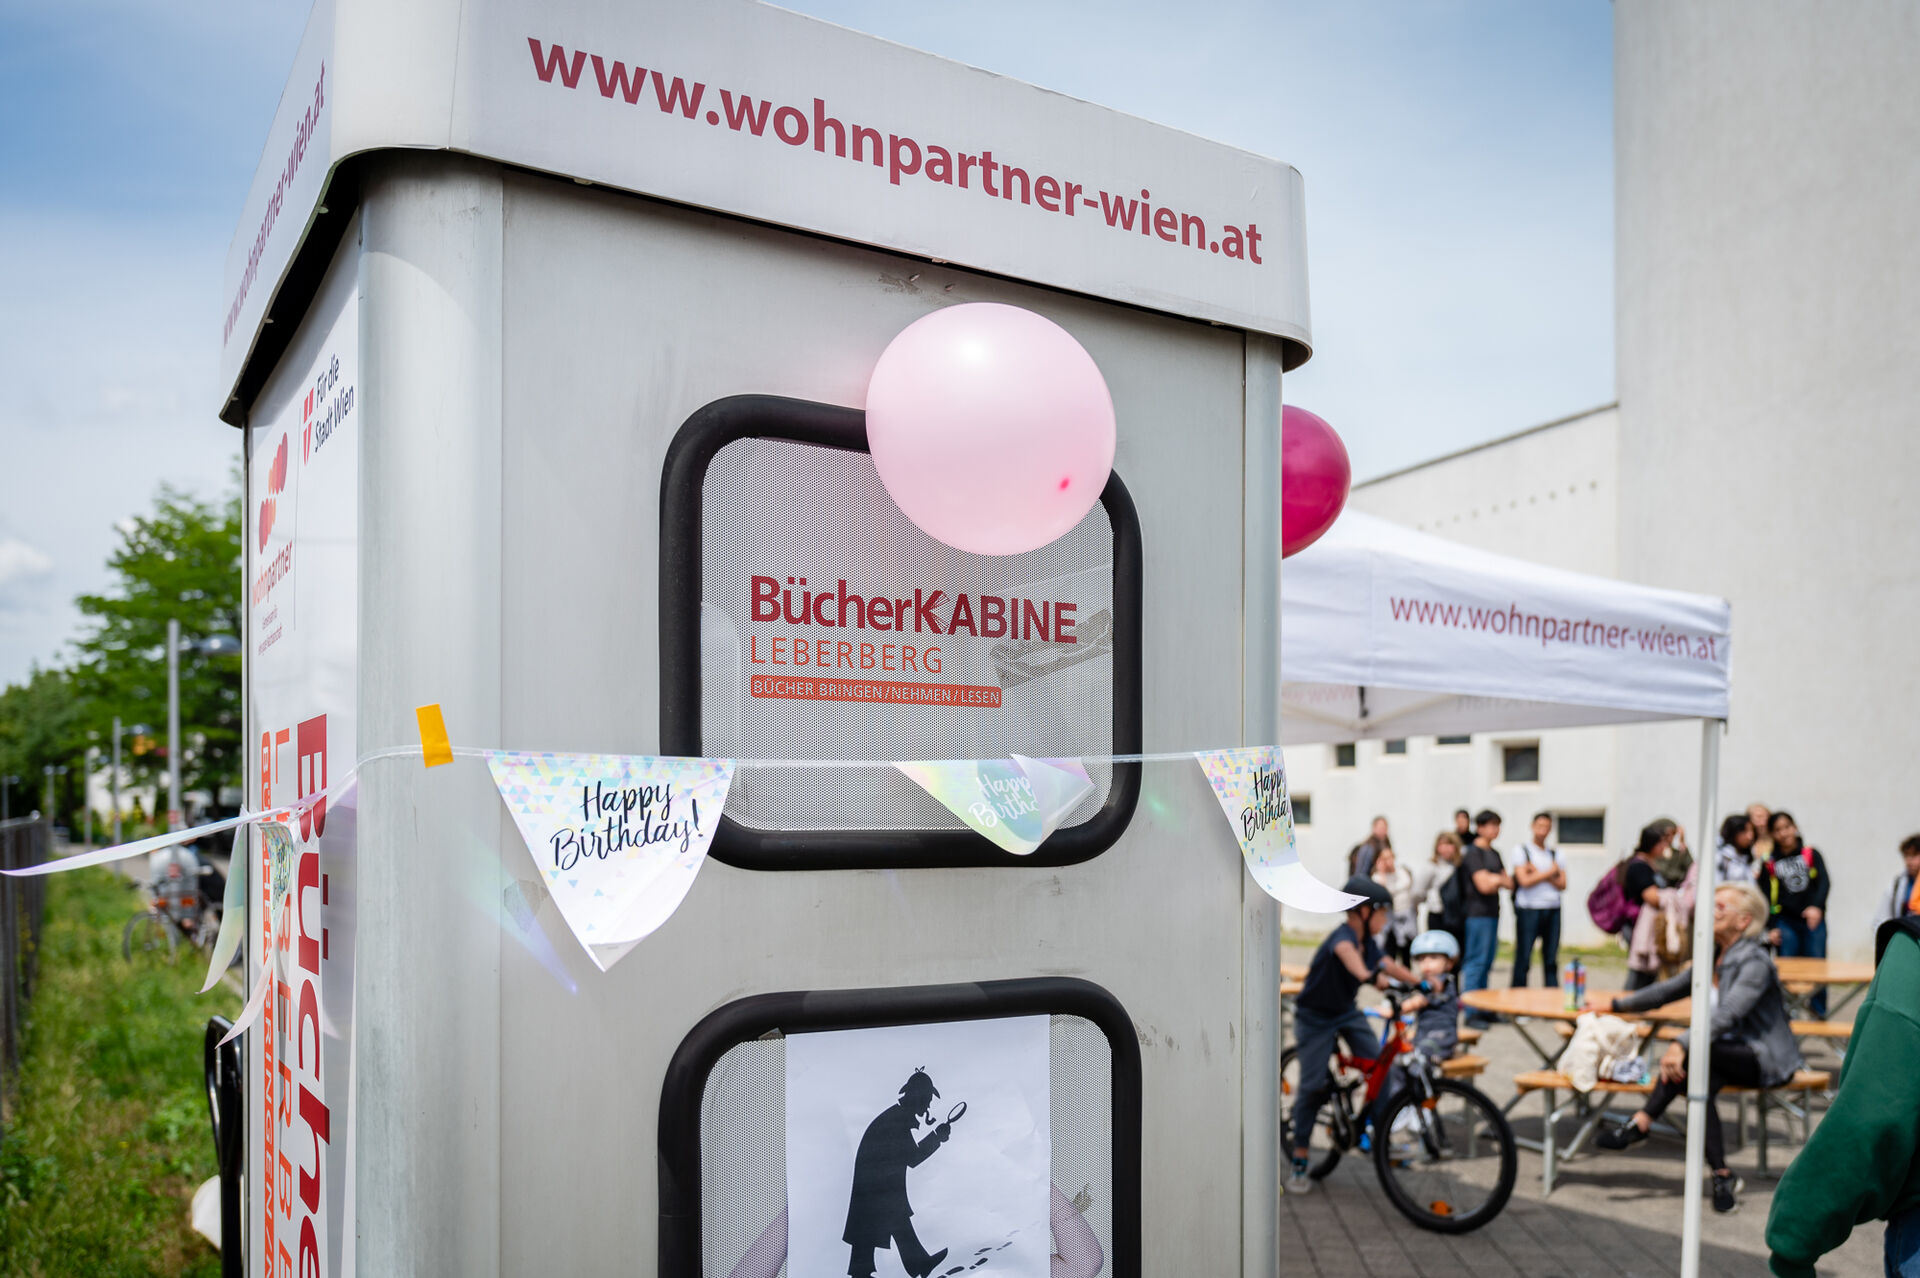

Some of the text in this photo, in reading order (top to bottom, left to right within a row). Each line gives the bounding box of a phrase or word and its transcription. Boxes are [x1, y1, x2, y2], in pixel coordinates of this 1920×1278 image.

[527, 37, 1263, 265] www.wohnpartner-wien.at
[316, 353, 340, 409] Für die
[315, 385, 355, 453] Stadt Wien
[252, 540, 292, 608] wohnpartner
[751, 635, 943, 674] LEBERBERG
[1390, 596, 1717, 662] www.wohnpartner-wien.at
[753, 678, 814, 696] BÜCHER
[579, 781, 676, 823] Happy
[975, 774, 1033, 800] Happ
[550, 798, 704, 870] Birthday!
